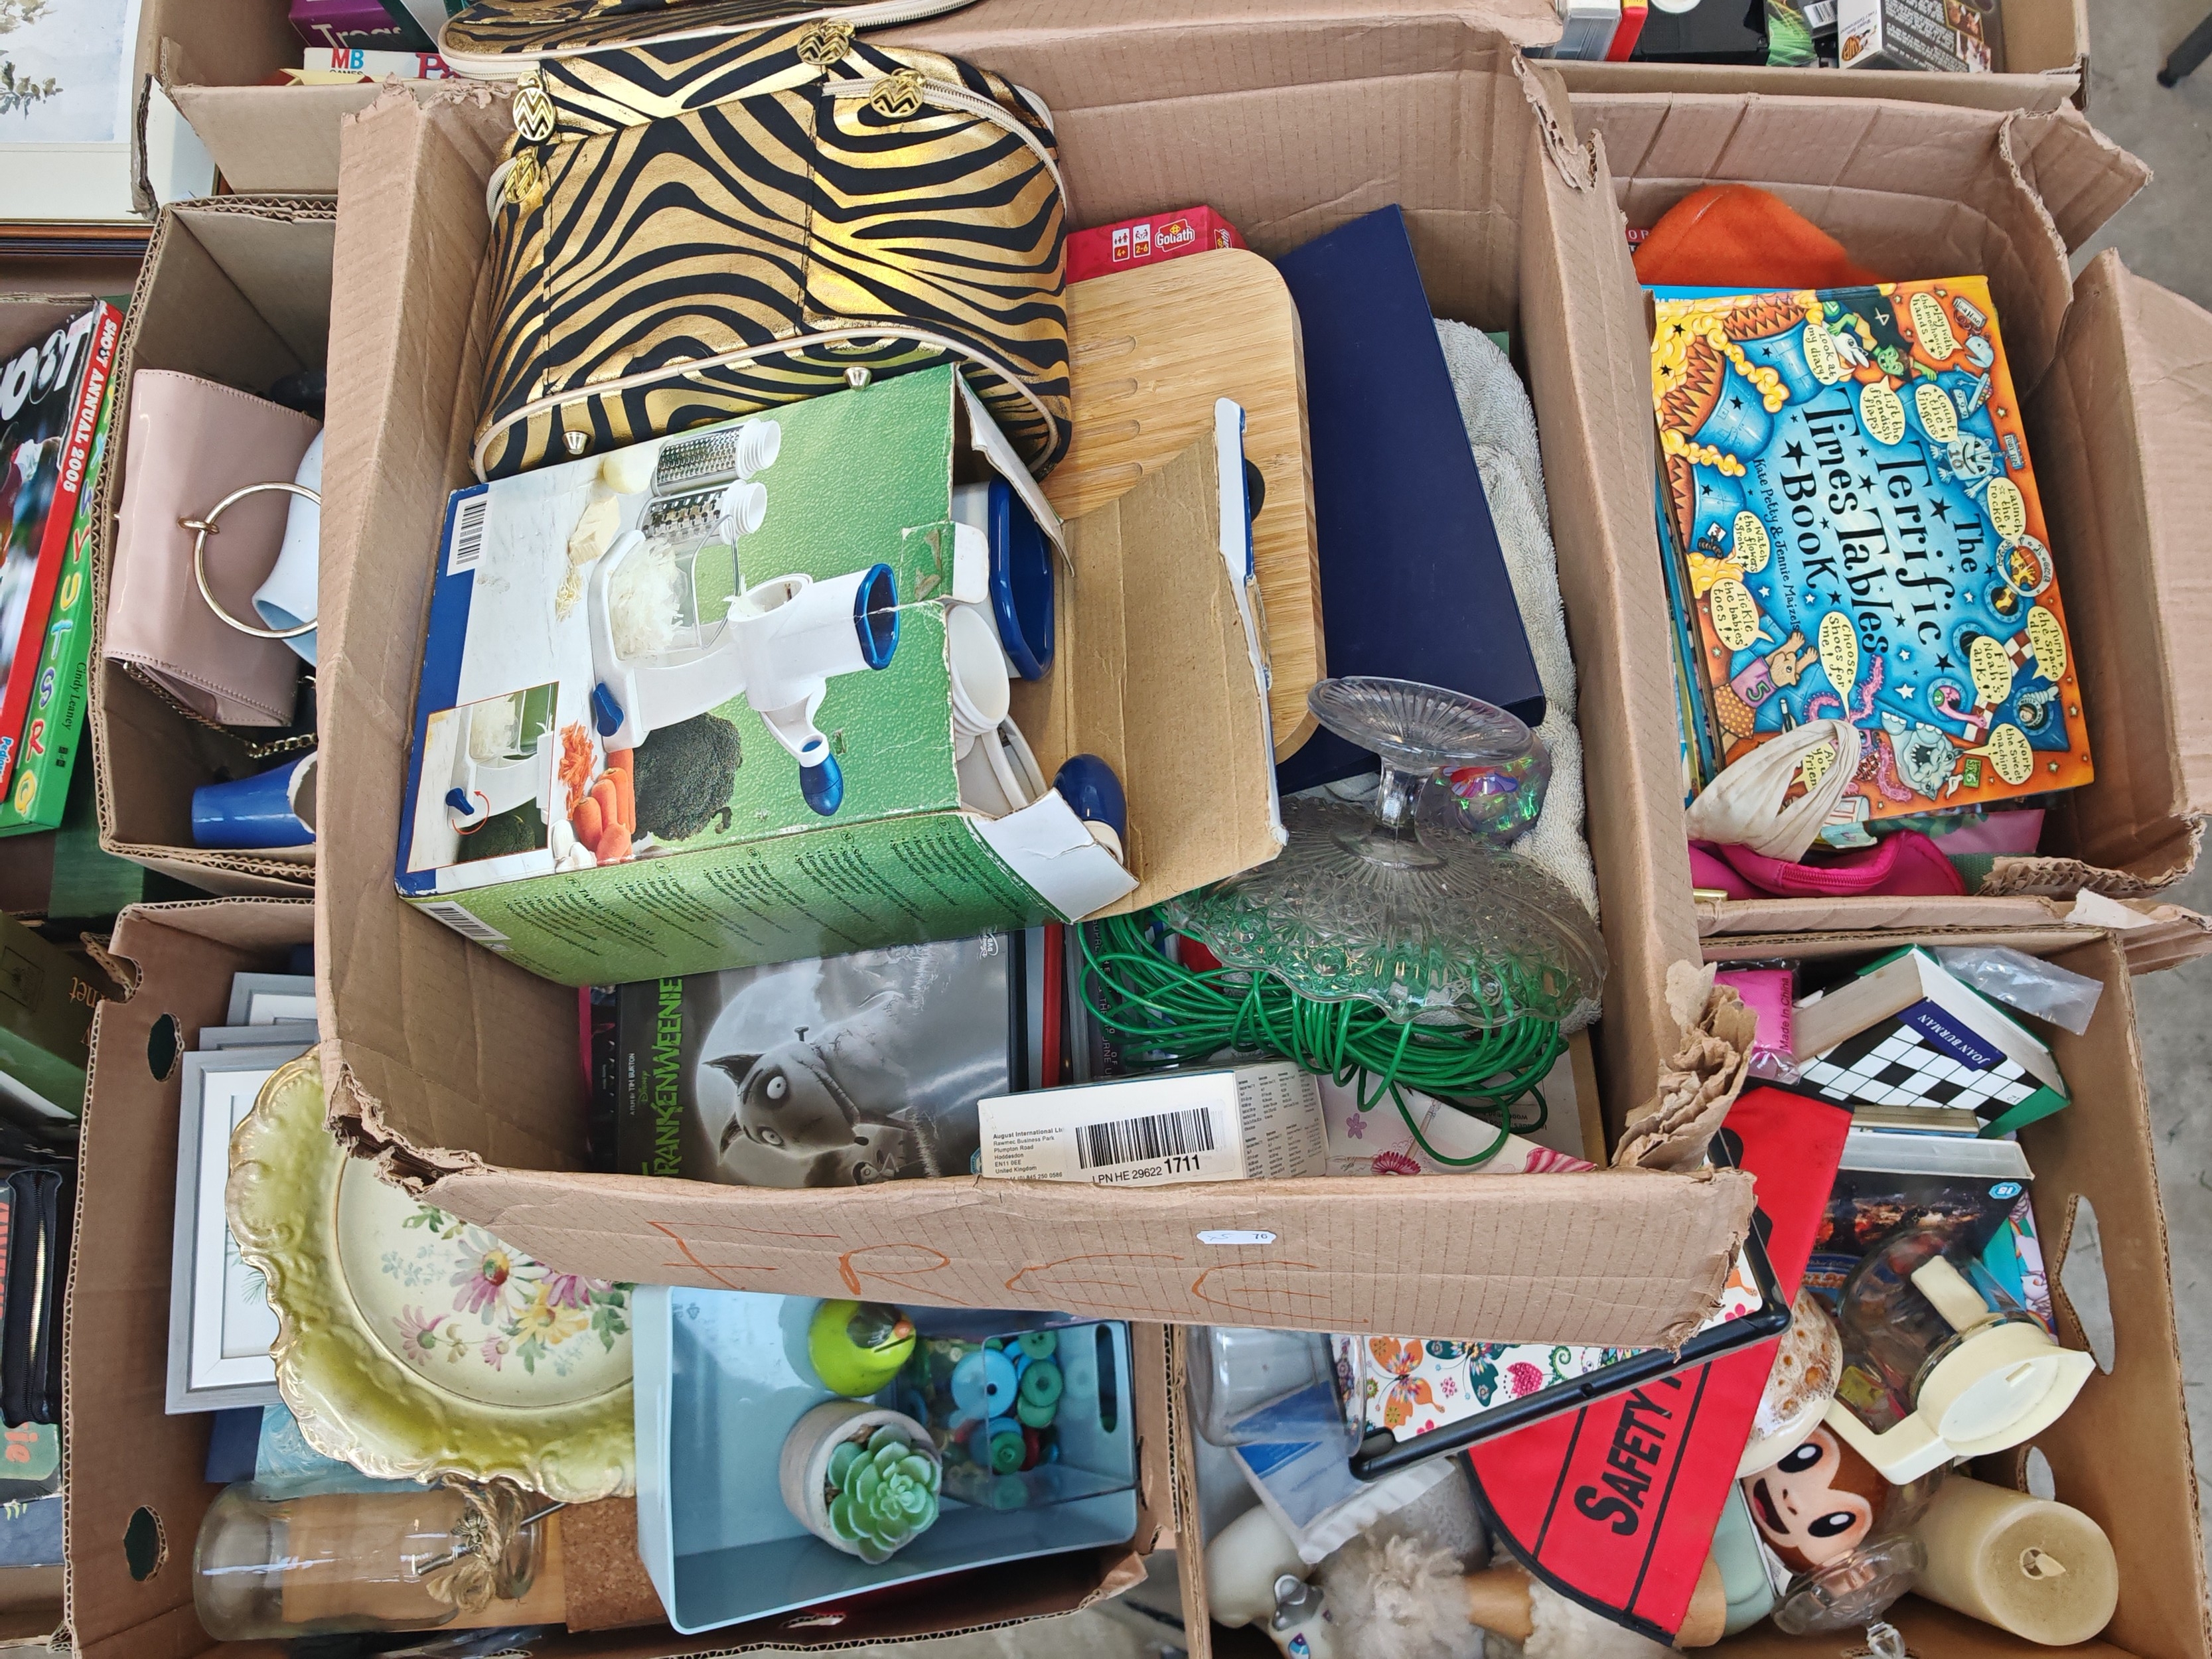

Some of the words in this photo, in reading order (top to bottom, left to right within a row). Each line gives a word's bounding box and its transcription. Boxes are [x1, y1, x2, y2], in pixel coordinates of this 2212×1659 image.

[332, 48, 364, 69] MB
[1136, 244, 1149, 253] 2-6
[1157, 228, 1194, 246] Goliath
[1116, 250, 1126, 258] 4+
[1929, 305, 1945, 327] Play
[1805, 327, 1817, 343] my
[1828, 364, 1837, 377] at
[74, 368, 105, 443] ANNUAL
[1870, 387, 1891, 440] fiendish
[1883, 392, 1897, 417] Lift
[1891, 421, 1902, 440] the
[1929, 399, 1943, 423] the
[1937, 394, 1956, 431] Count
[1753, 458, 1769, 486] Kate
[1948, 449, 1964, 470] 10
[1760, 487, 1779, 522] Petty
[2001, 500, 2010, 521] the
[2008, 488, 2023, 533] Launch
[1770, 526, 1785, 539] &
[1801, 387, 1860, 515] Times
[1834, 507, 1895, 654] Tables
[1875, 439, 1954, 645] Terrific
[1953, 514, 1985, 573] The
[1775, 539, 1790, 581] Jennie
[1724, 581, 1734, 603] the
[1784, 585, 1802, 631] Maizels
[2037, 612, 2050, 636] the
[1841, 624, 1854, 676] Choose
[2050, 625, 2063, 657] Turn
[73, 662, 86, 691] Cindy
[1830, 664, 1844, 687] for
[1994, 652, 2008, 681] Fill
[1747, 680, 1770, 701] 5
[63, 691, 82, 732] Leaney
[2006, 728, 2016, 743] the
[749, 849, 759, 857] GB
[1780, 977, 1789, 1006] China
[1780, 1019, 1789, 1050] Made
[1917, 1013, 1960, 1050] BURMAN
[1961, 1045, 1990, 1065] JOAN
[1015, 1128, 1053, 1137] International
[1115, 1171, 1130, 1182] HE
[1132, 1166, 1163, 1179] 29622
[1164, 1154, 1200, 1174] 1711
[1574, 1388, 1673, 1536] SAFETY
